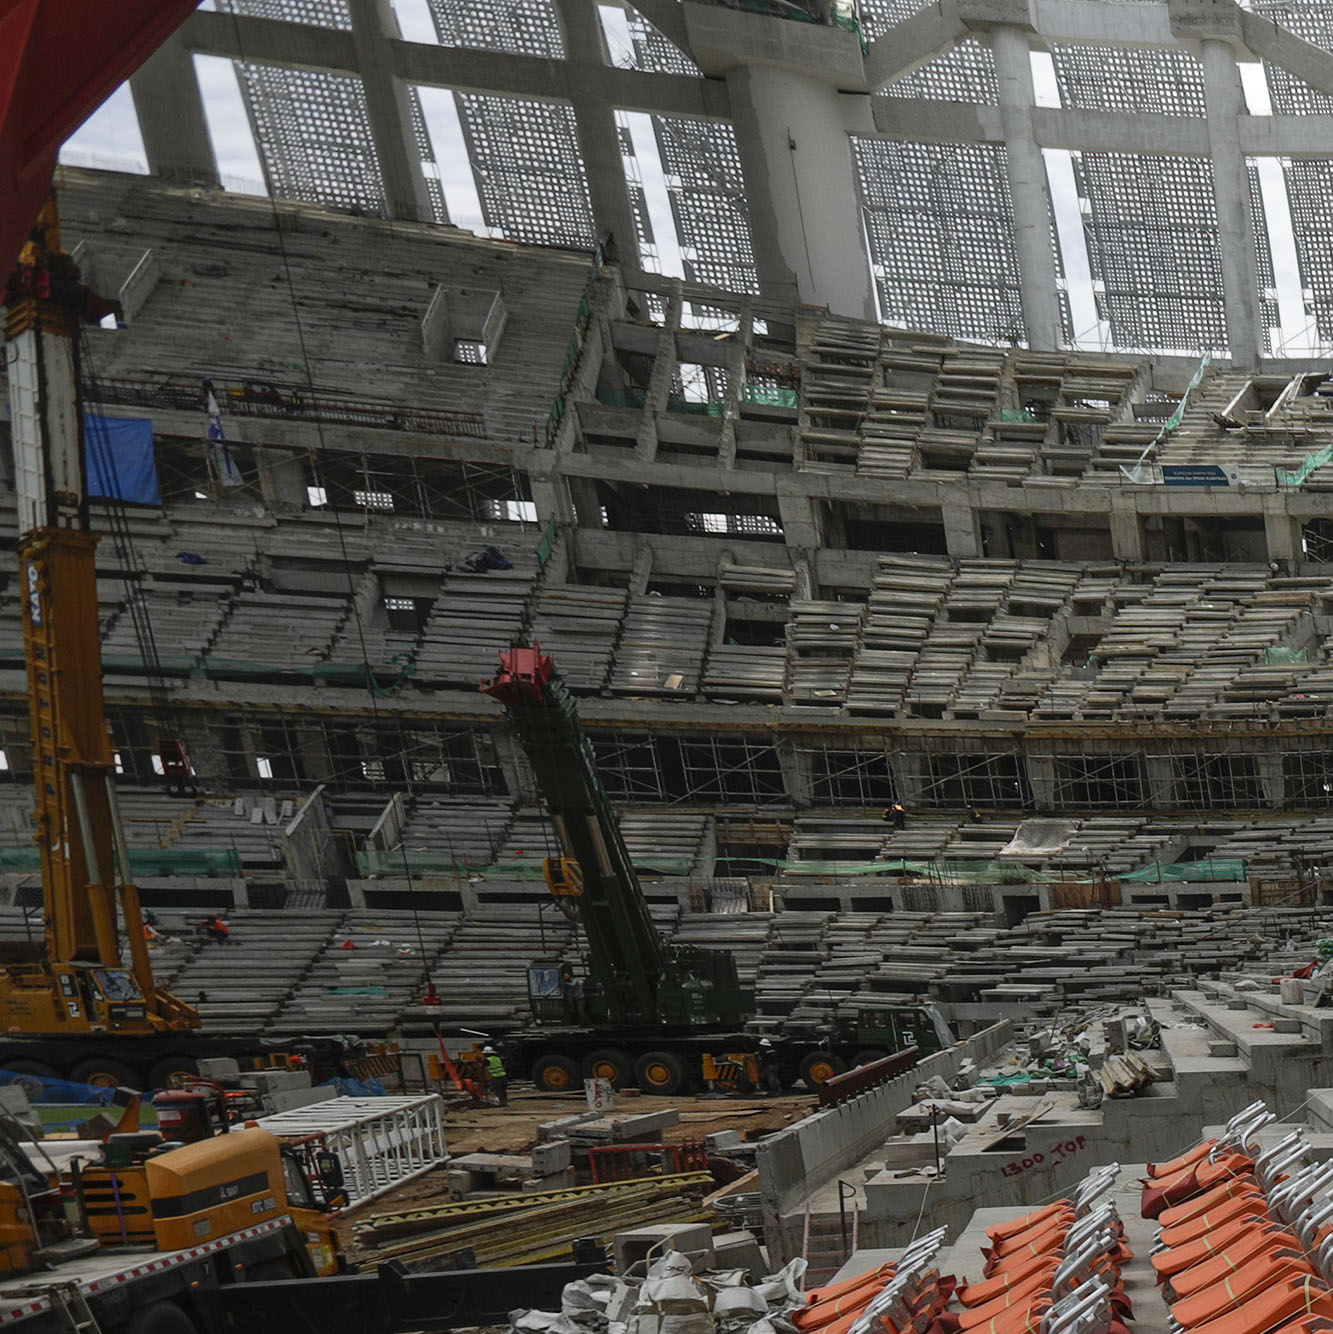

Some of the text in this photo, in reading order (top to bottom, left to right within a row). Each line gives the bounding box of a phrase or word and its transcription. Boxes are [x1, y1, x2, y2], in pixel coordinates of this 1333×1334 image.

[28, 566, 41, 622] KATO
[36, 647, 54, 795] PROTON
[1051, 1135, 1085, 1158] TOP
